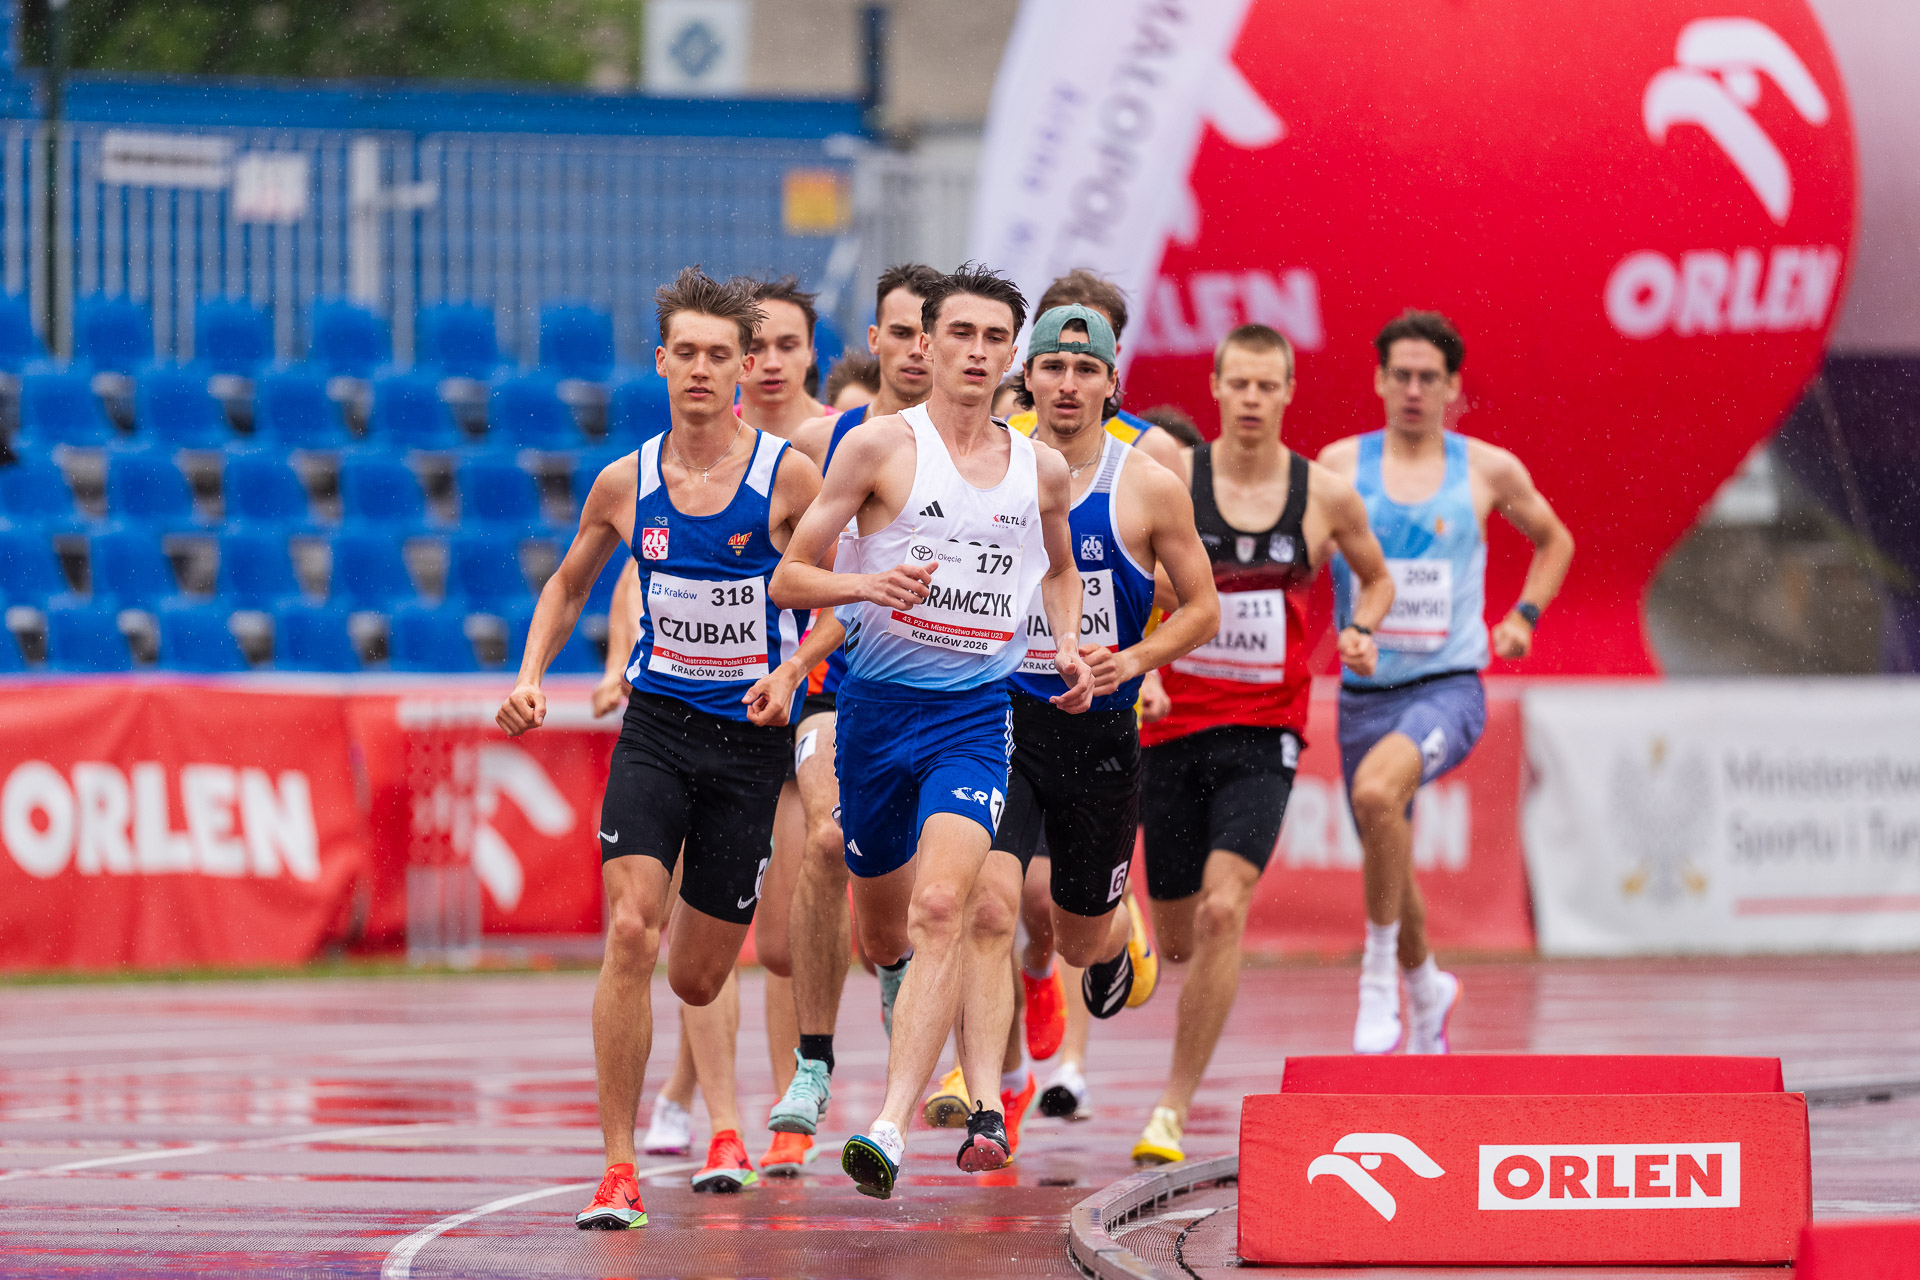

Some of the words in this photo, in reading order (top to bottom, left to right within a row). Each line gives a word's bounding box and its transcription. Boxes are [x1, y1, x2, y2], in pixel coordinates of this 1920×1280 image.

[1604, 245, 1843, 339] ORLEN
[938, 554, 961, 563] Okęcie
[976, 553, 1013, 575] 179
[664, 587, 697, 599] Kraków
[711, 586, 754, 606] 318
[921, 584, 1011, 617] RAMCZYK
[1237, 601, 1273, 618] 211
[659, 616, 756, 645] CZUBAK
[902, 616, 912, 624] 43.
[913, 619, 929, 629] PZLA
[930, 624, 970, 636] Mistrzostwa
[971, 630, 989, 638] Polski
[911, 630, 961, 647] KRAKÓW
[963, 640, 988, 650] 2026
[1207, 631, 1268, 650] LIAN
[671, 664, 715, 677] KRAKÓW
[718, 669, 743, 677] 2026
[684, 657, 722, 665] Mistrzostwa
[1023, 661, 1056, 670] KRAKÓ
[2, 759, 320, 882] ORLEN
[1112, 868, 1125, 893] 6
[1493, 1154, 1722, 1200] ORLEN
